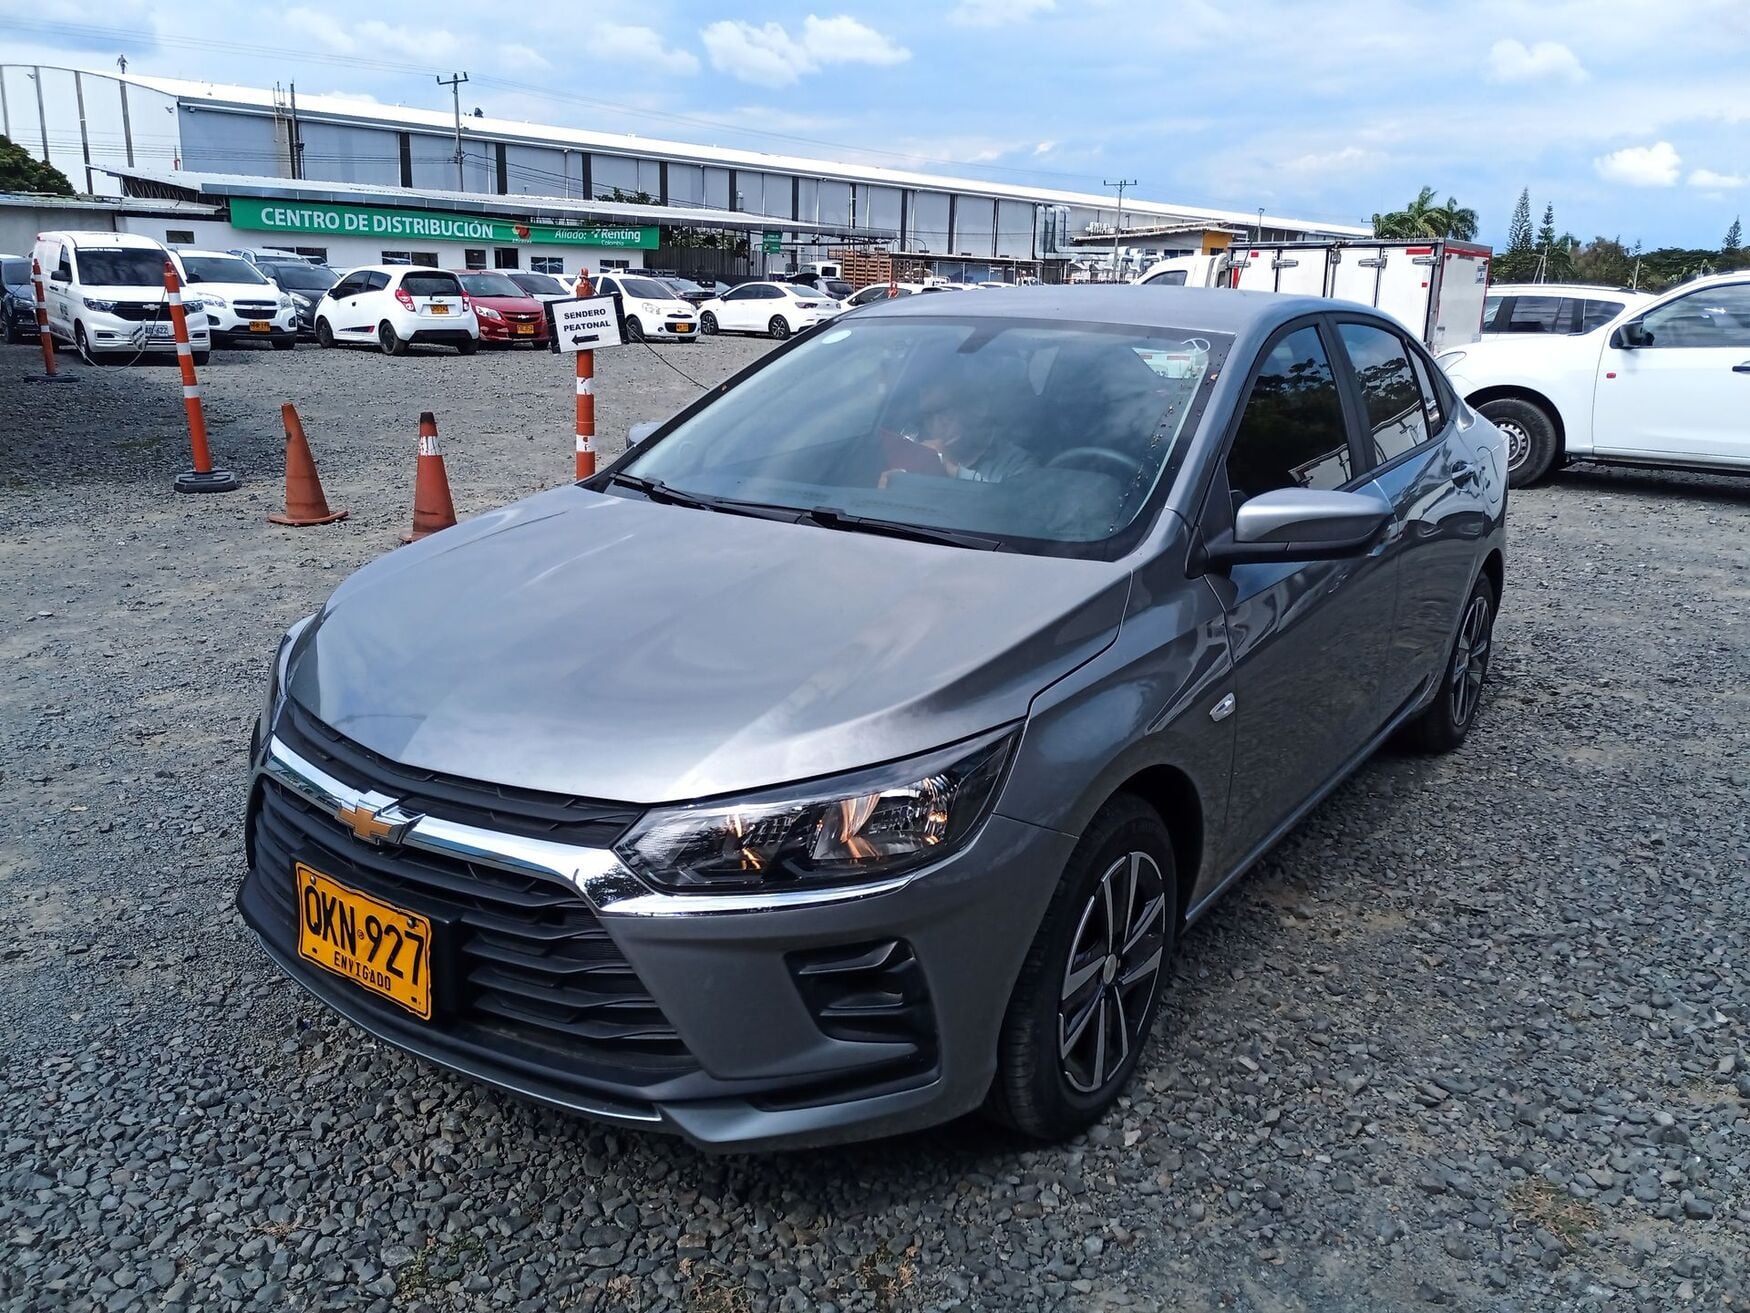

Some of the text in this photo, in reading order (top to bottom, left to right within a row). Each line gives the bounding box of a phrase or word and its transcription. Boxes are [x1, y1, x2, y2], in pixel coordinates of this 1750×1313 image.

[261, 207, 494, 239] CENTRO DE DISTRIBUCIÓN
[555, 229, 587, 240] Aliado:
[601, 228, 641, 242] Renting
[564, 308, 606, 320] SENDERO
[563, 320, 611, 332] PEATONAL
[334, 951, 391, 991] ENVIGADO
